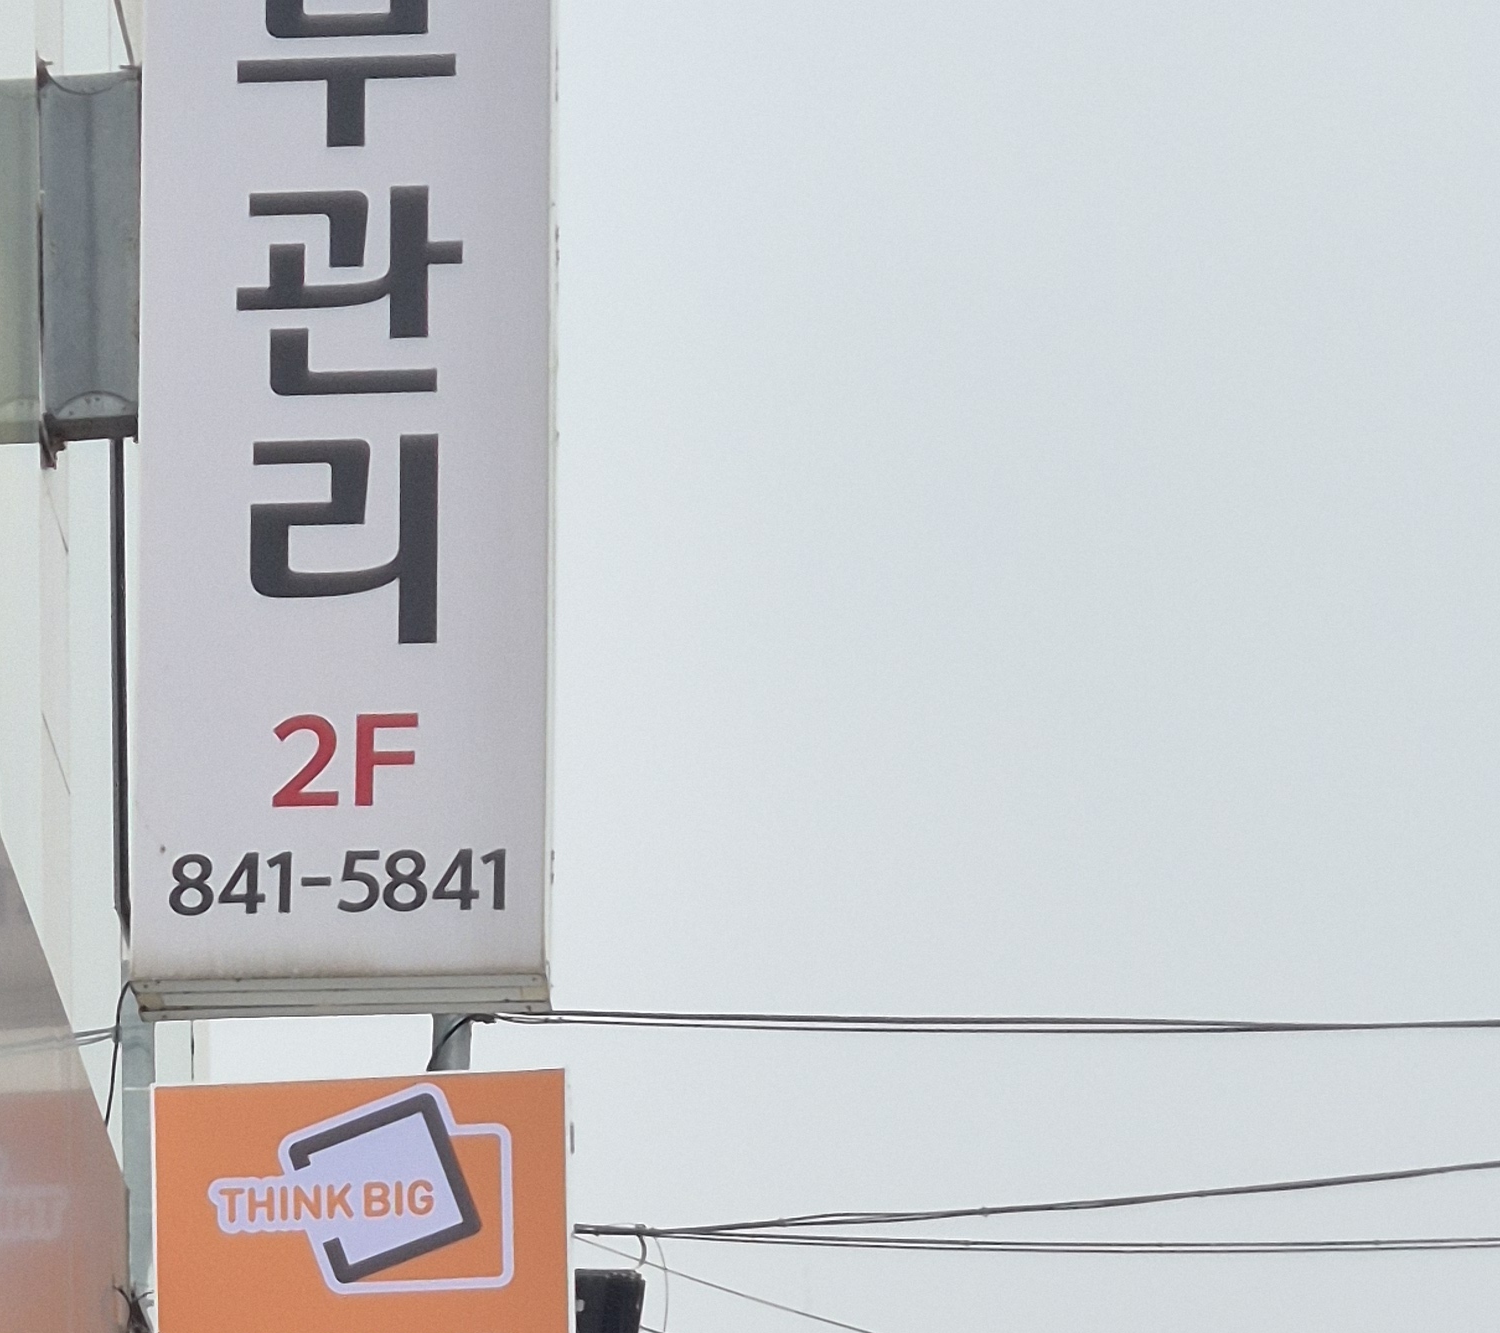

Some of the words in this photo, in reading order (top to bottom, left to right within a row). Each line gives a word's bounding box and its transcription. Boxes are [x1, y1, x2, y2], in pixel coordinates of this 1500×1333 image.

[272, 712, 419, 809] 2F
[169, 848, 507, 916] 841-5841
[217, 1180, 354, 1226] THINK
[362, 1177, 435, 1219] BIG
